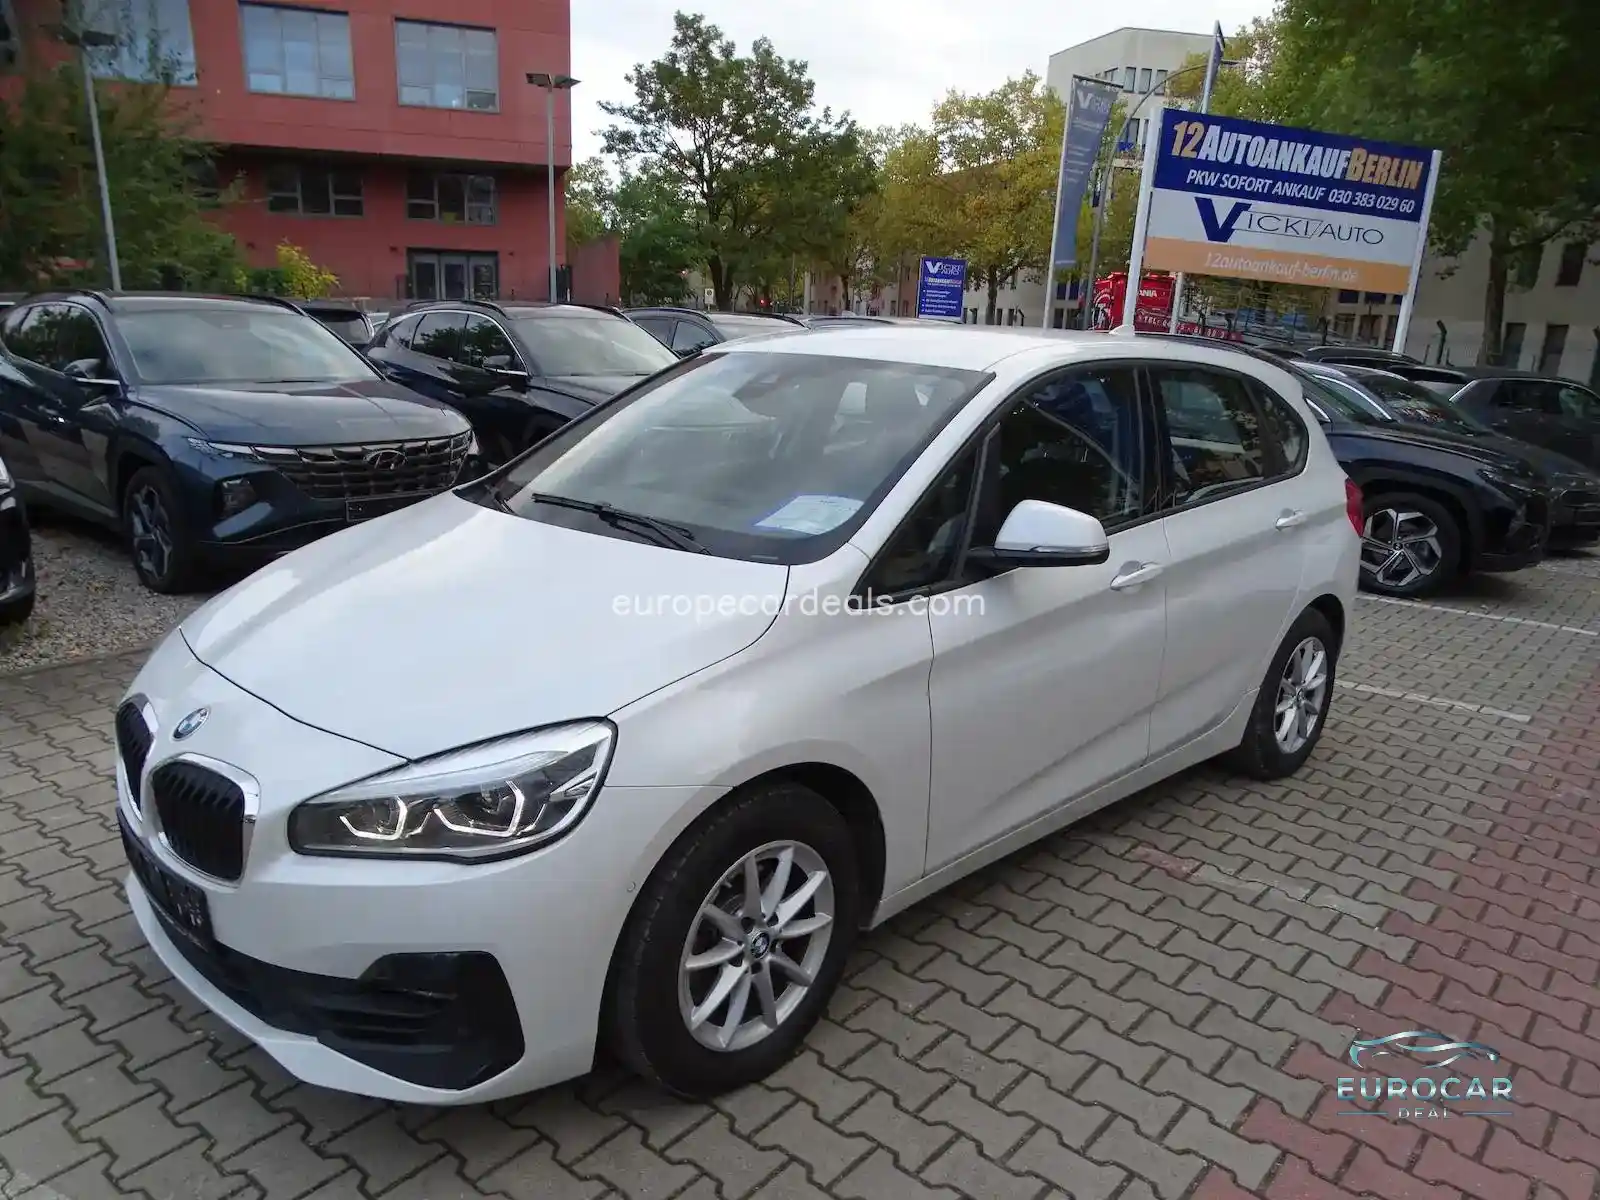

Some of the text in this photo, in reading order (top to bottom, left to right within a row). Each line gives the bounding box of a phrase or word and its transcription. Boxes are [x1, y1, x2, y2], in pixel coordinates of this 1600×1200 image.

[1186, 169, 1415, 213] PKW SOFORT ANKAUF 030 383 029 60
[1205, 252, 1359, 280] 12autoankauf-berlin.de
